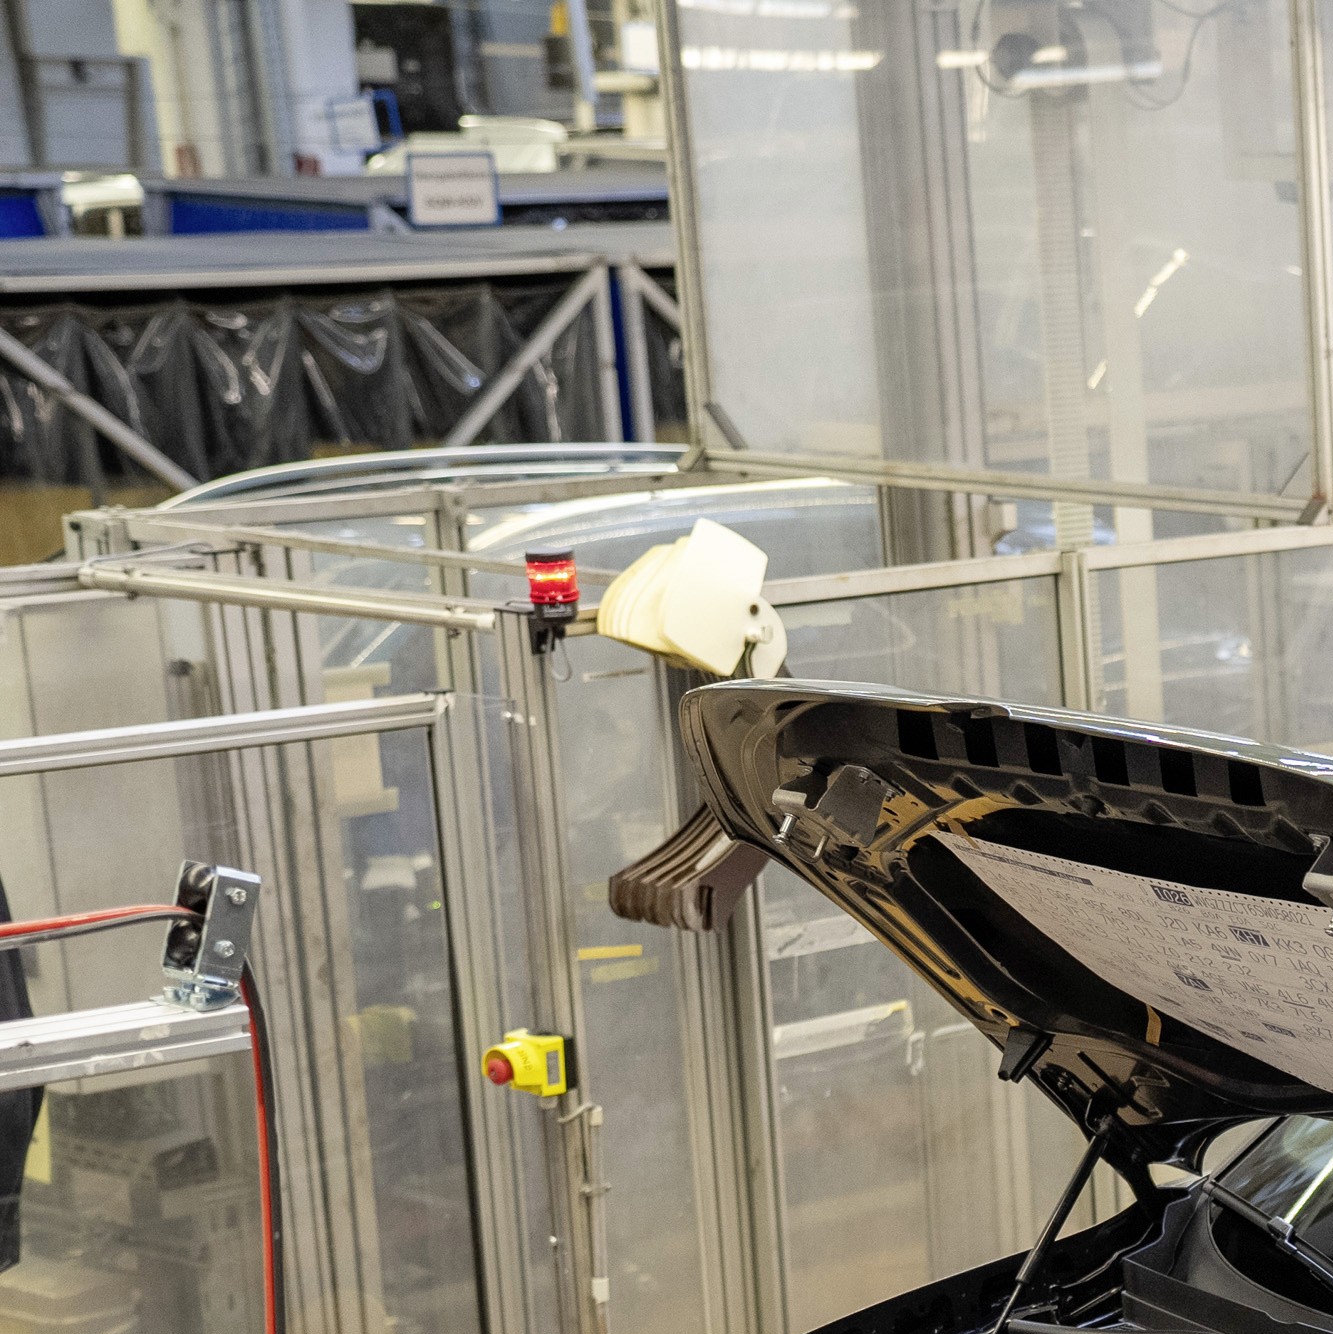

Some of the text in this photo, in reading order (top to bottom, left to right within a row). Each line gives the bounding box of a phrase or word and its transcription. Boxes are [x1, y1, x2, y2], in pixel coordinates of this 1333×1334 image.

[1154, 887, 1190, 905] 1026
[1157, 915, 1188, 932] J2D
[1192, 922, 1228, 940] KA6
[1233, 929, 1268, 946] KH7
[1272, 937, 1308, 955] KK3
[1171, 934, 1202, 951] 1A5
[1211, 943, 1242, 959] 4VN
[1222, 961, 1257, 978] 2J2
[1235, 979, 1270, 996] VW5
[1276, 988, 1310, 1006] 4L6
[1253, 996, 1286, 1013] 7K3
[1289, 1006, 1324, 1023] 7L6
[1302, 1023, 1333, 1040] 8X7
